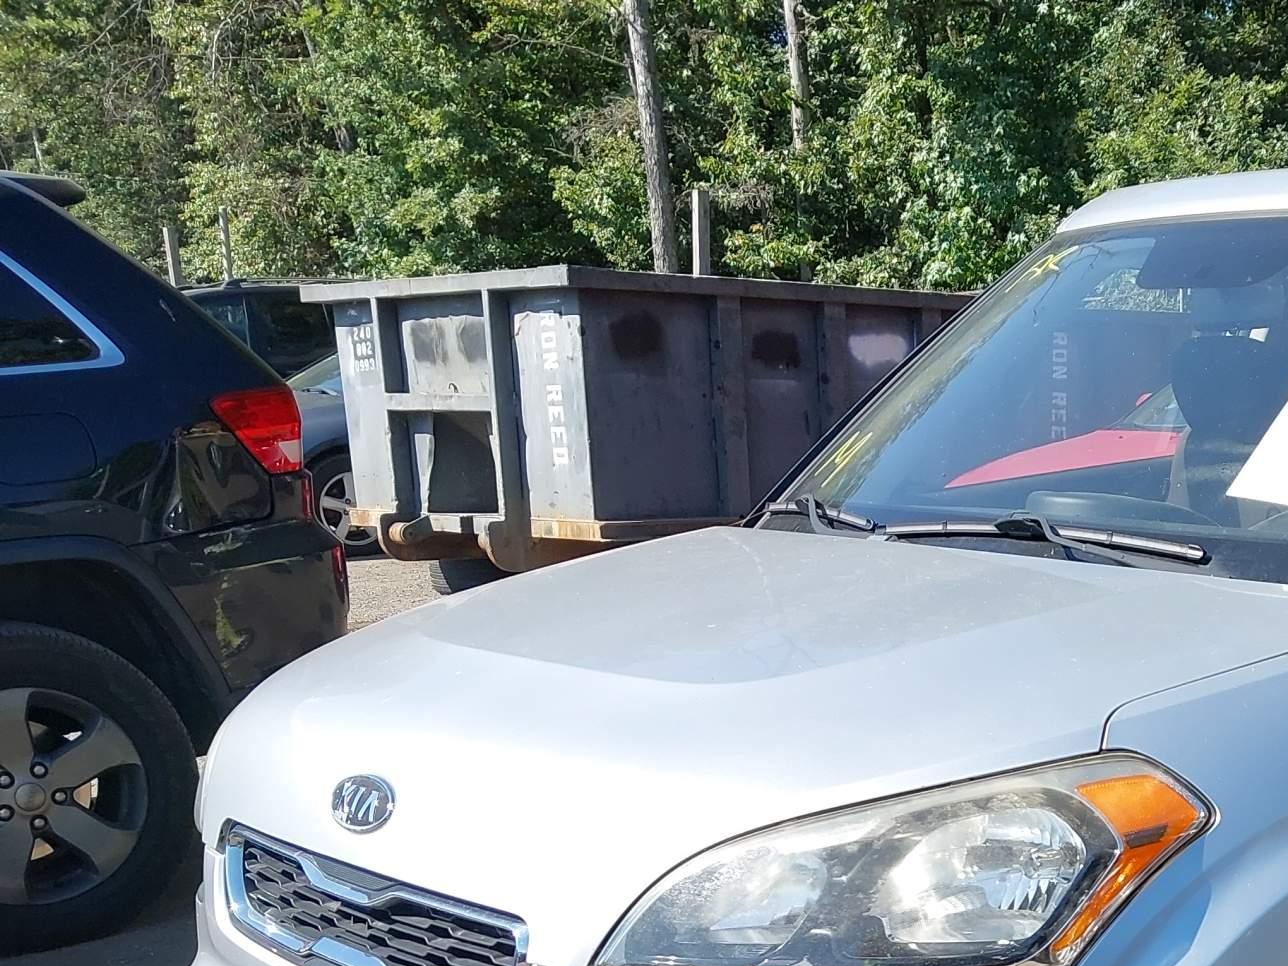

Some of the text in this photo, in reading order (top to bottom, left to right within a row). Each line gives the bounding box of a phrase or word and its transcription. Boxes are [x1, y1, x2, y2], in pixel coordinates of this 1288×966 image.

[353, 326, 371, 341] 240
[1052, 331, 1069, 379] RON
[540, 310, 569, 465] RON REED
